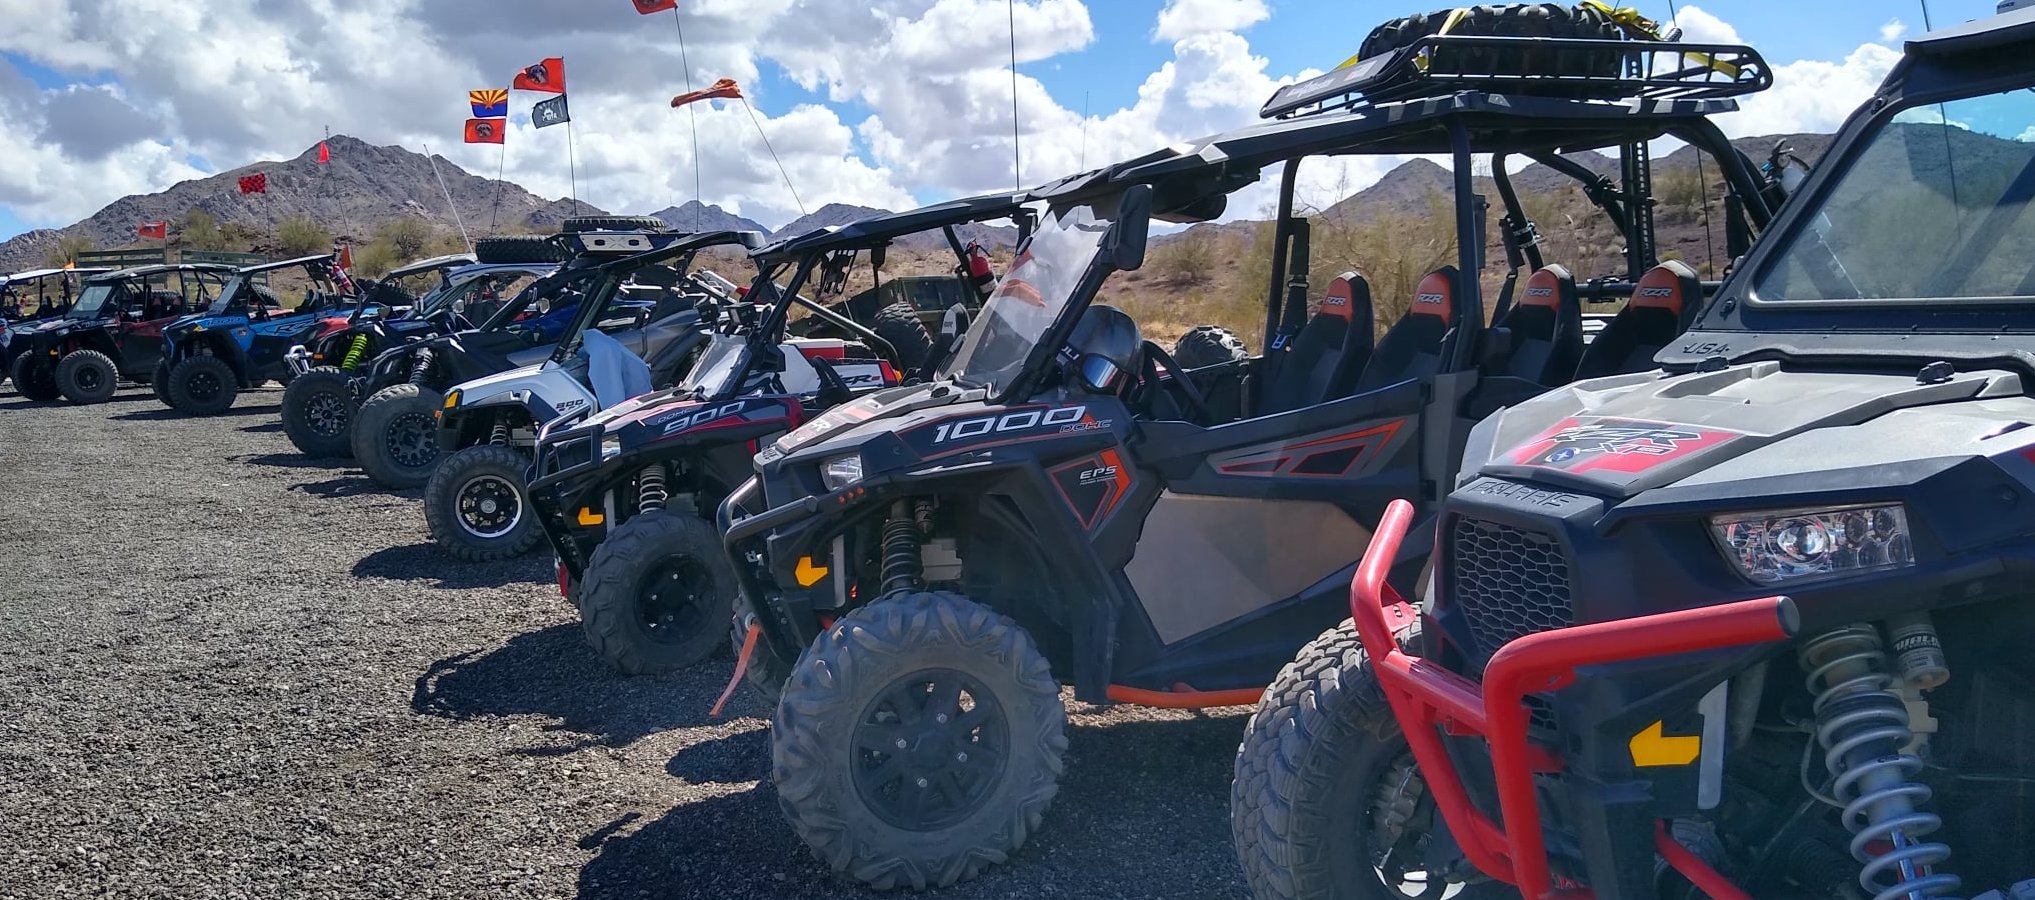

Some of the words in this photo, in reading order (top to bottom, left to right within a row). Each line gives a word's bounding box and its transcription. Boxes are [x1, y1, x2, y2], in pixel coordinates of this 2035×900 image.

[1417, 293, 1444, 304] RZR
[1526, 287, 1553, 297] RZR
[1640, 287, 1673, 298] RZR
[1325, 296, 1346, 306] RZR
[1683, 342, 1729, 355] USA
[662, 400, 746, 436] 900
[932, 405, 1087, 444] 1000
[1058, 418, 1113, 434] DOHC
[1079, 464, 1118, 480] EPS
[1465, 480, 1580, 507] POLARIS
